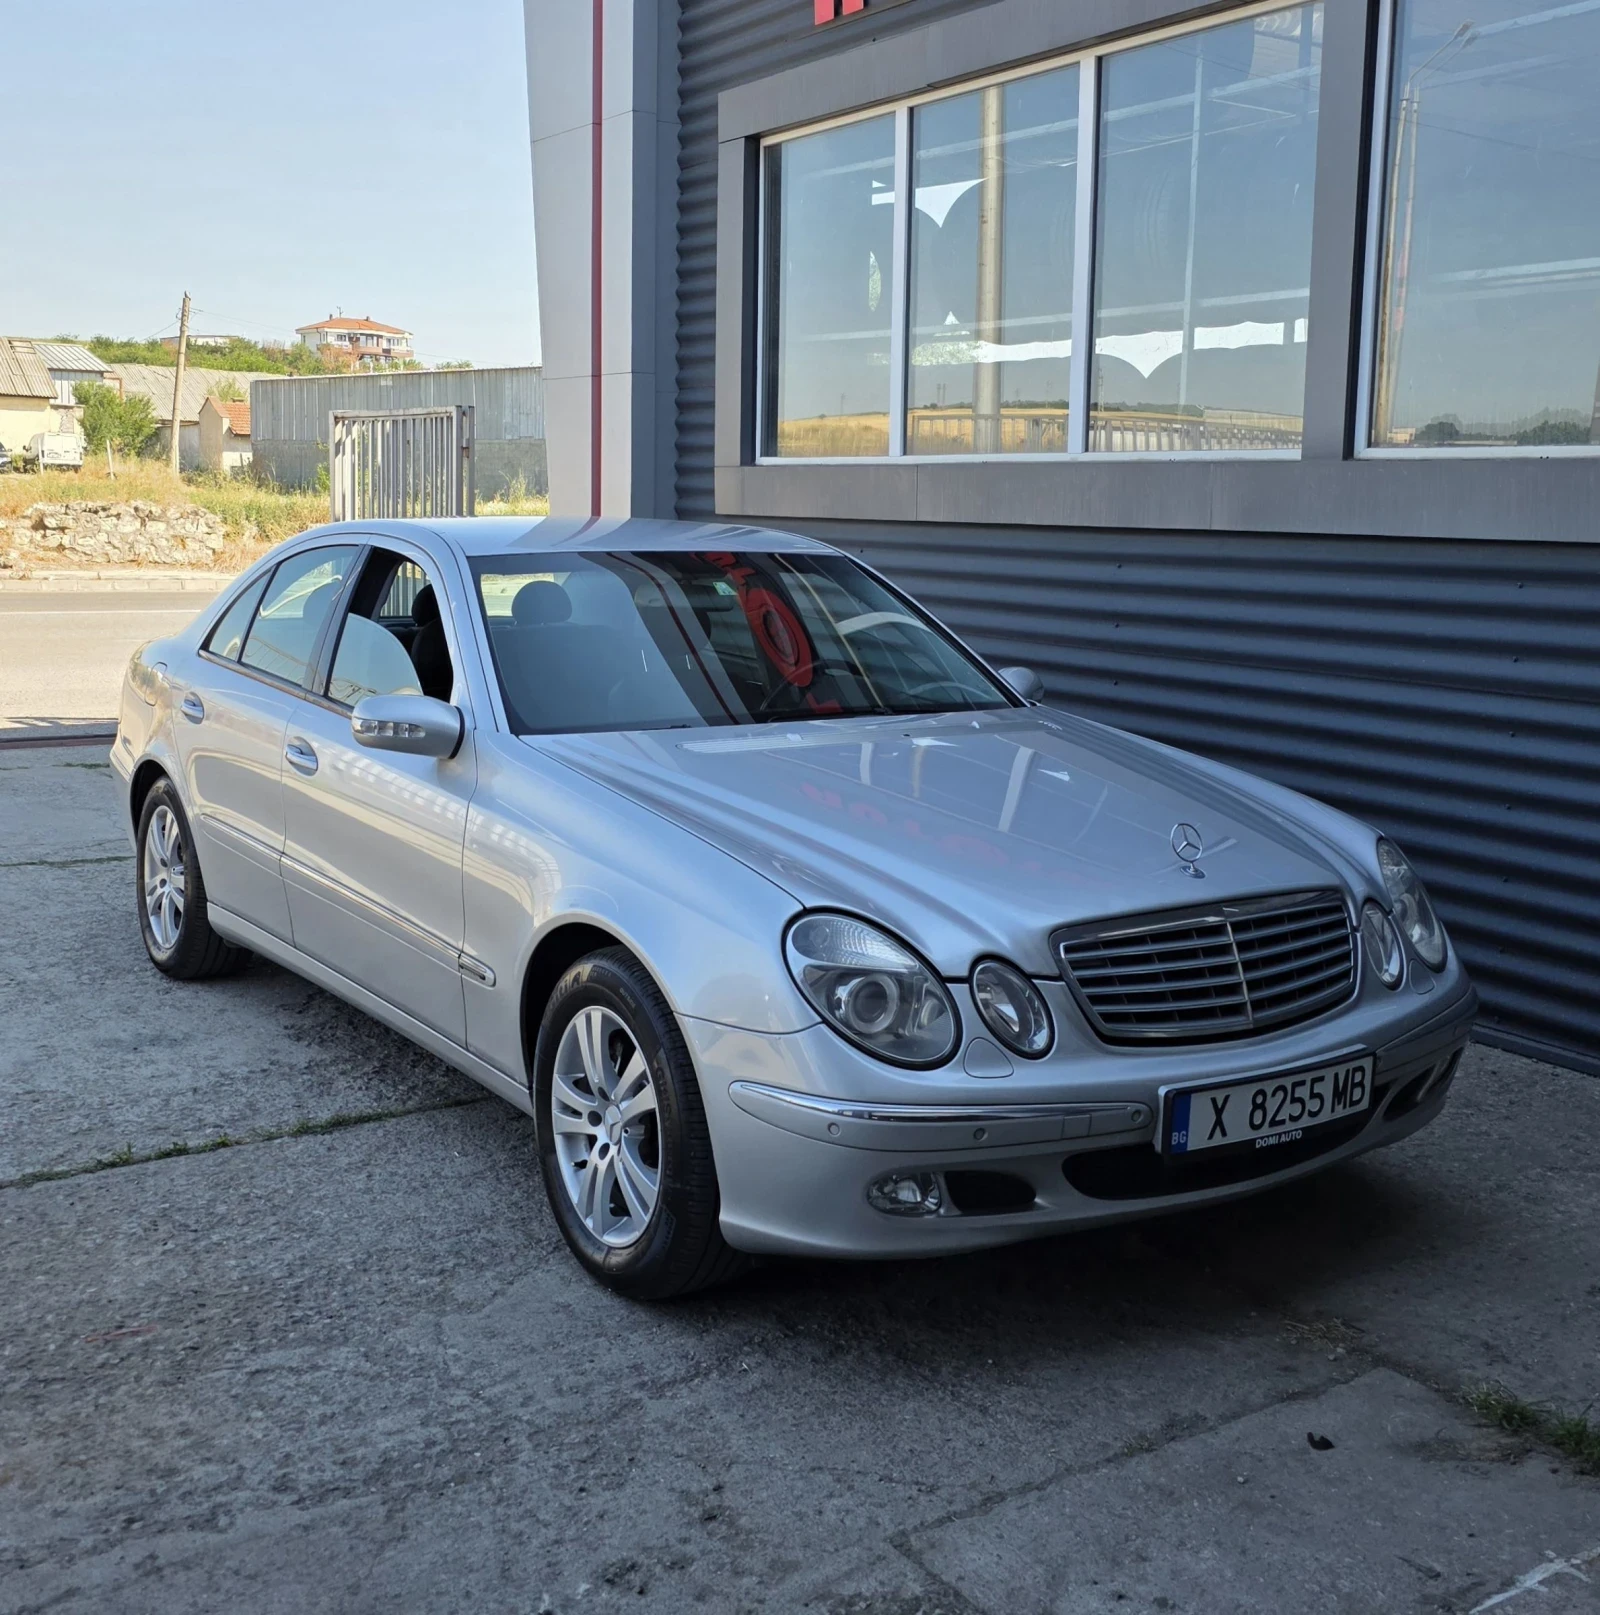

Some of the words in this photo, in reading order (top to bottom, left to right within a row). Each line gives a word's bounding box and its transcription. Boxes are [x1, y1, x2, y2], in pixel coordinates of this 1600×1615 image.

[1207, 1094, 1231, 1140] X
[1249, 1076, 1325, 1131] 8255
[1331, 1065, 1366, 1114] MB
[1171, 1131, 1187, 1145] BG
[1255, 1135, 1279, 1149] DOMI
[1279, 1130, 1303, 1144] AUTO
